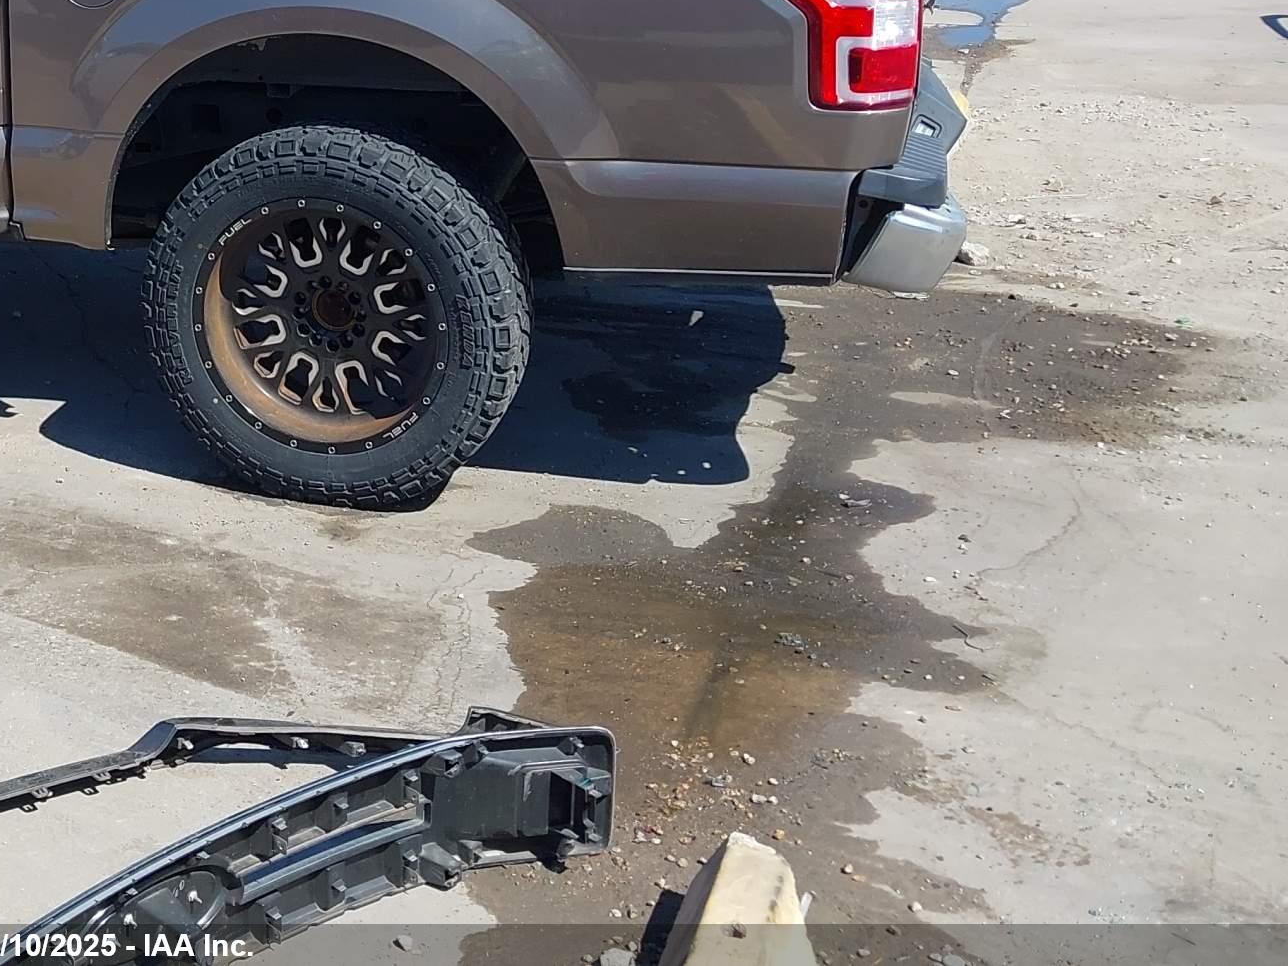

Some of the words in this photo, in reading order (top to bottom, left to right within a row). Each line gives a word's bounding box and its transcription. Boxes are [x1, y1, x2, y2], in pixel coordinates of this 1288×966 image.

[218, 217, 253, 247] FUEL
[455, 294, 475, 368] KENDA
[381, 411, 419, 439] FUEL
